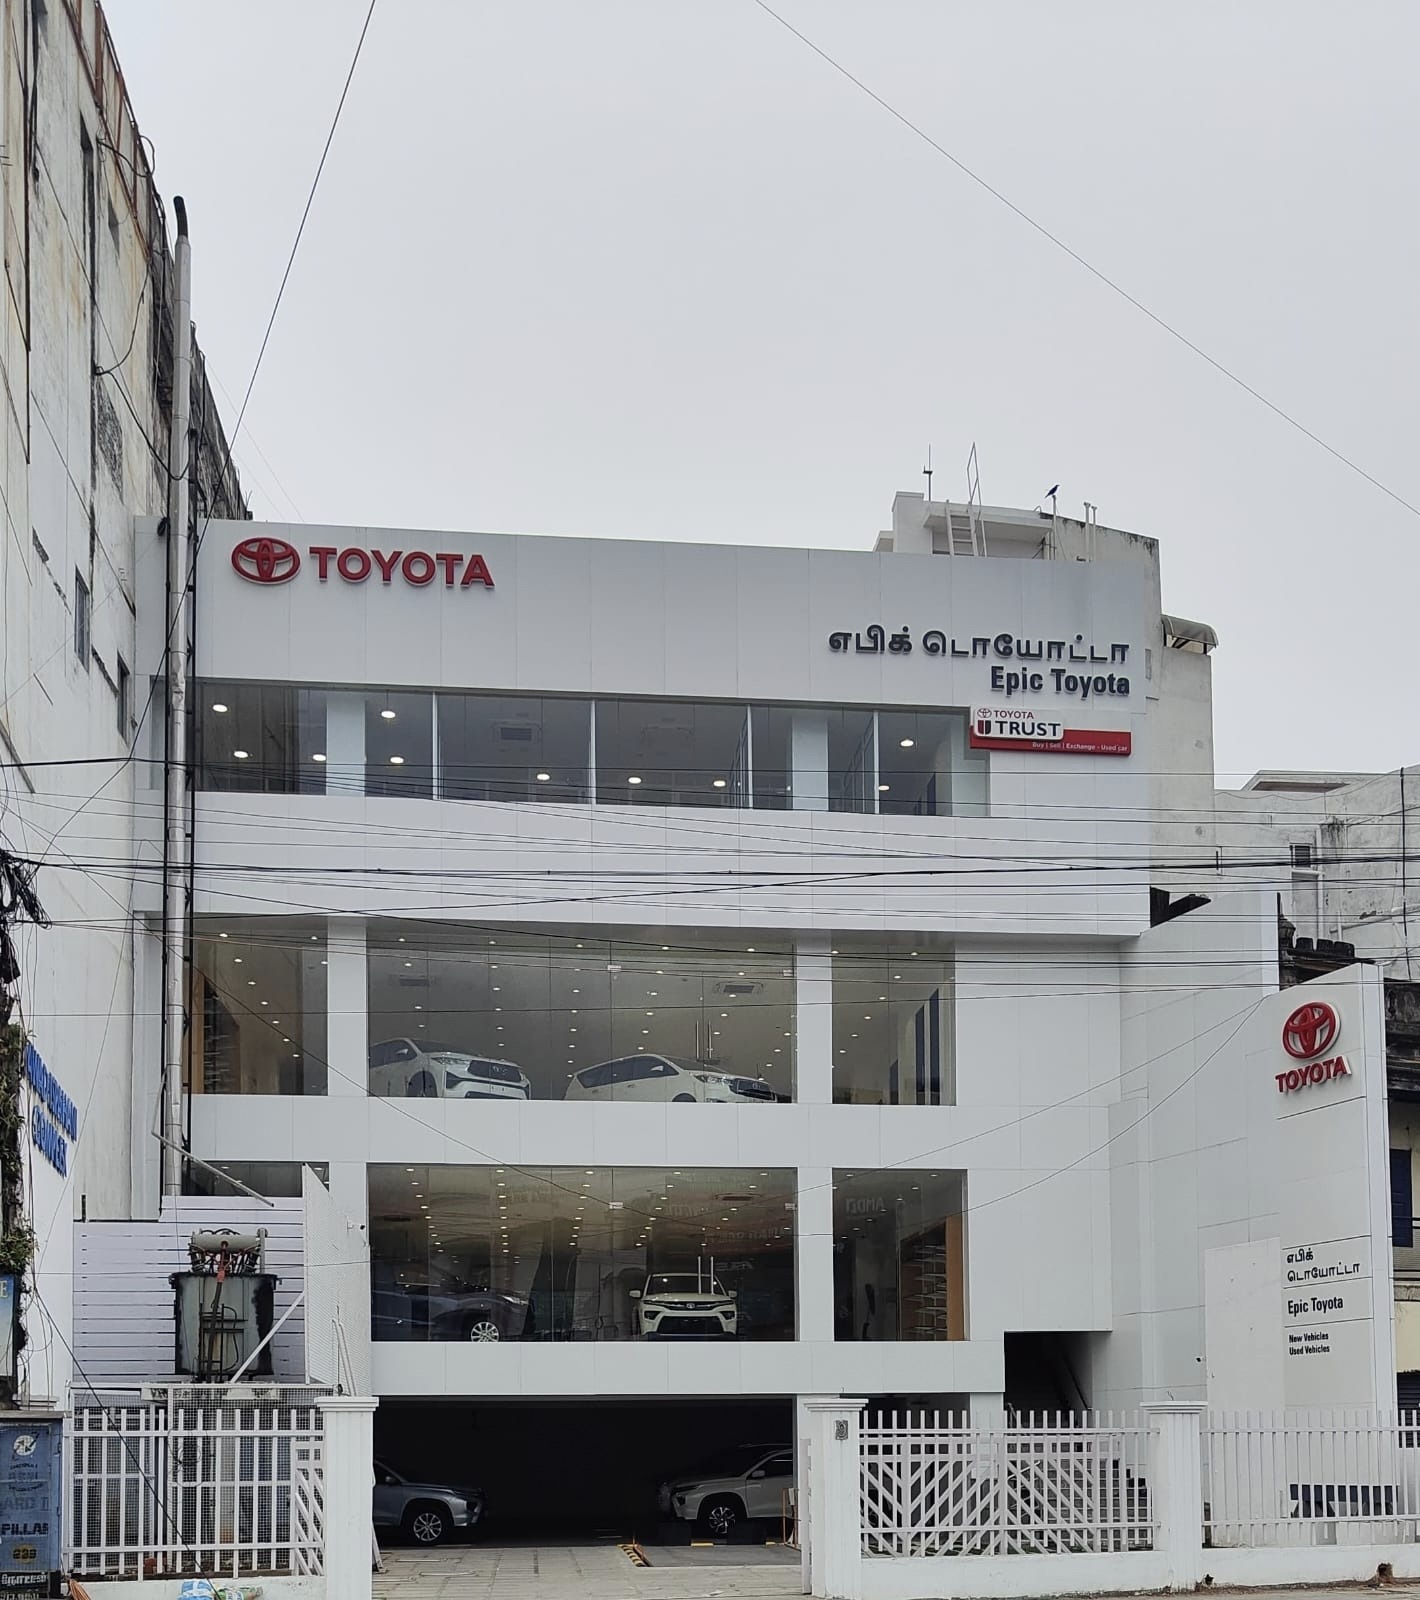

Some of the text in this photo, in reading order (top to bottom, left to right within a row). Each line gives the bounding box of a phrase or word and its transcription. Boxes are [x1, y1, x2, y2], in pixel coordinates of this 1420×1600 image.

[308, 546, 495, 588] TOYOTA
[828, 624, 1130, 663] எபிக் டொயோட்டா
[990, 665, 1130, 699] Epic Toyota
[993, 710, 1035, 719] TOYOTA
[995, 721, 1061, 737] TRUST
[1275, 1056, 1348, 1093] TOYOTA
[1286, 1248, 1314, 1263] எபிக்
[1287, 1261, 1361, 1282] டொயோட்டா
[1287, 1297, 1344, 1317] Epic Toyota
[1288, 1331, 1329, 1343] New Vehicles
[1289, 1344, 1330, 1356] Used Vehicles
